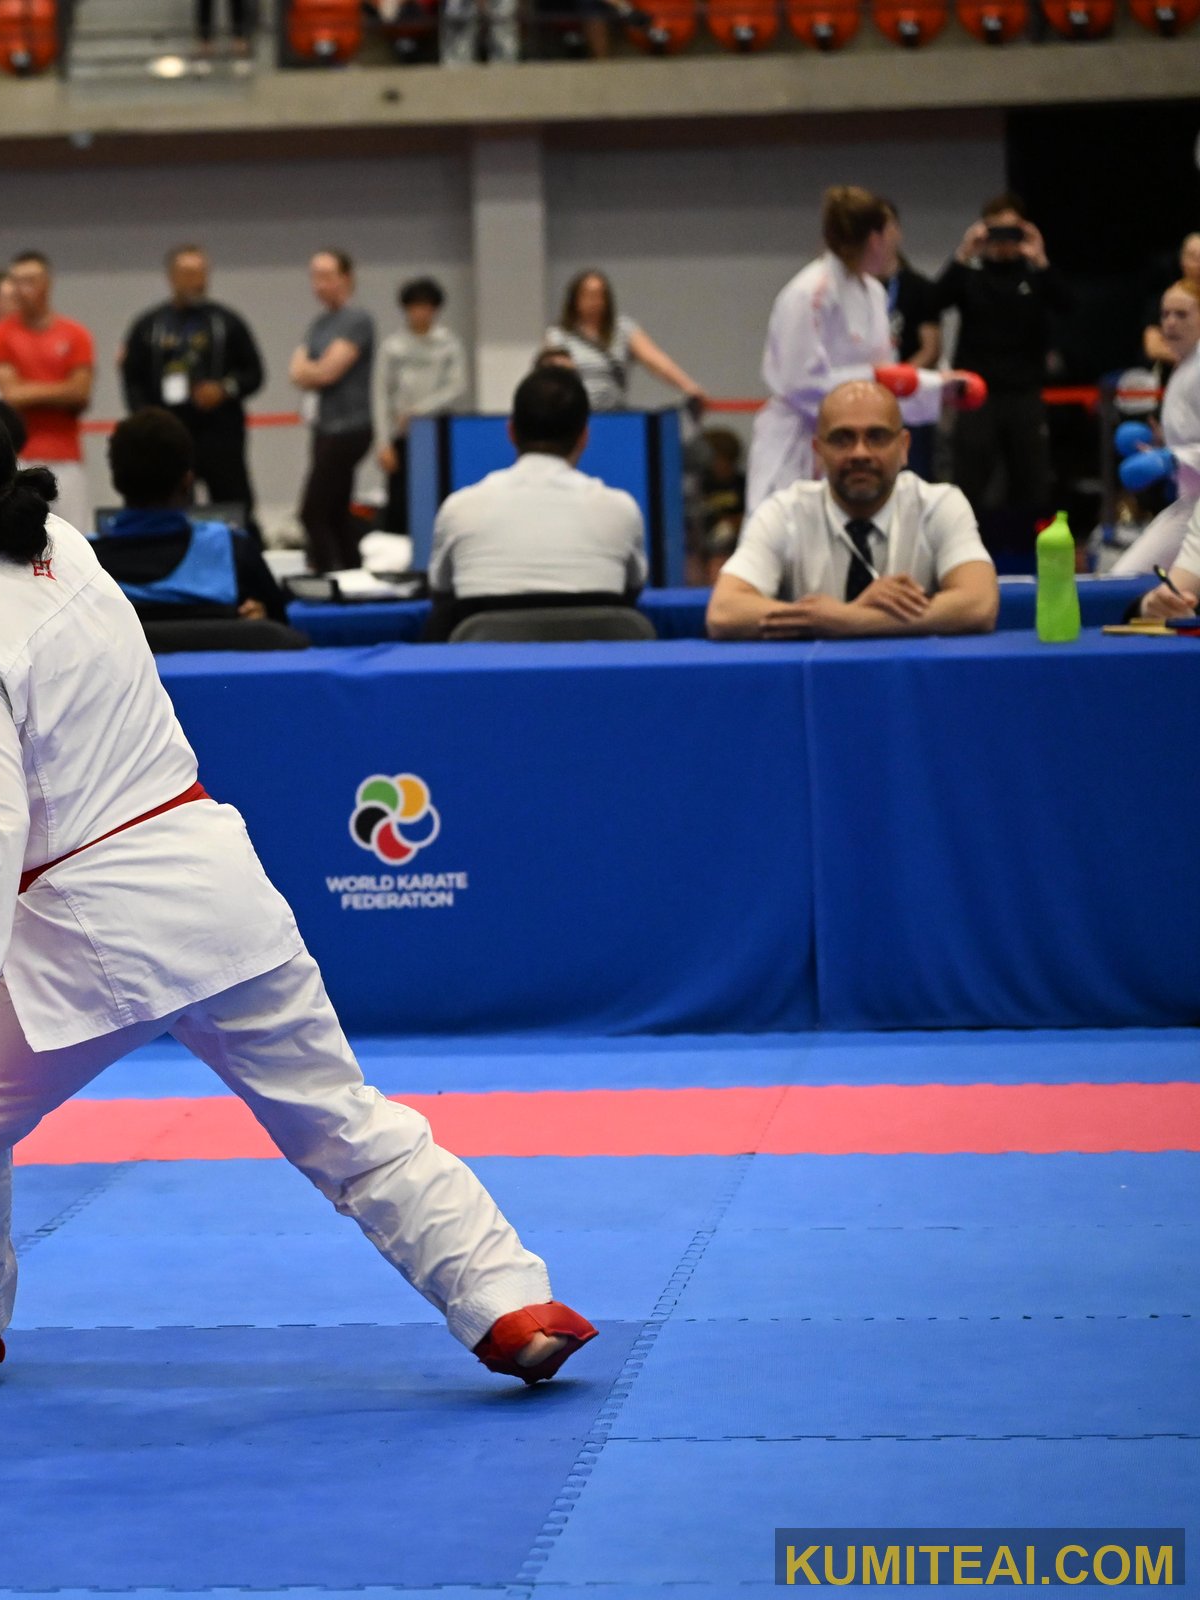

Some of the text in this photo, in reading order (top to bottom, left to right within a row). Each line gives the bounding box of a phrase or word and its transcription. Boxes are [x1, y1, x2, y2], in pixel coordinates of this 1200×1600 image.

[326, 872, 467, 892] WORLD KARATE
[341, 891, 453, 909] FEDERATION
